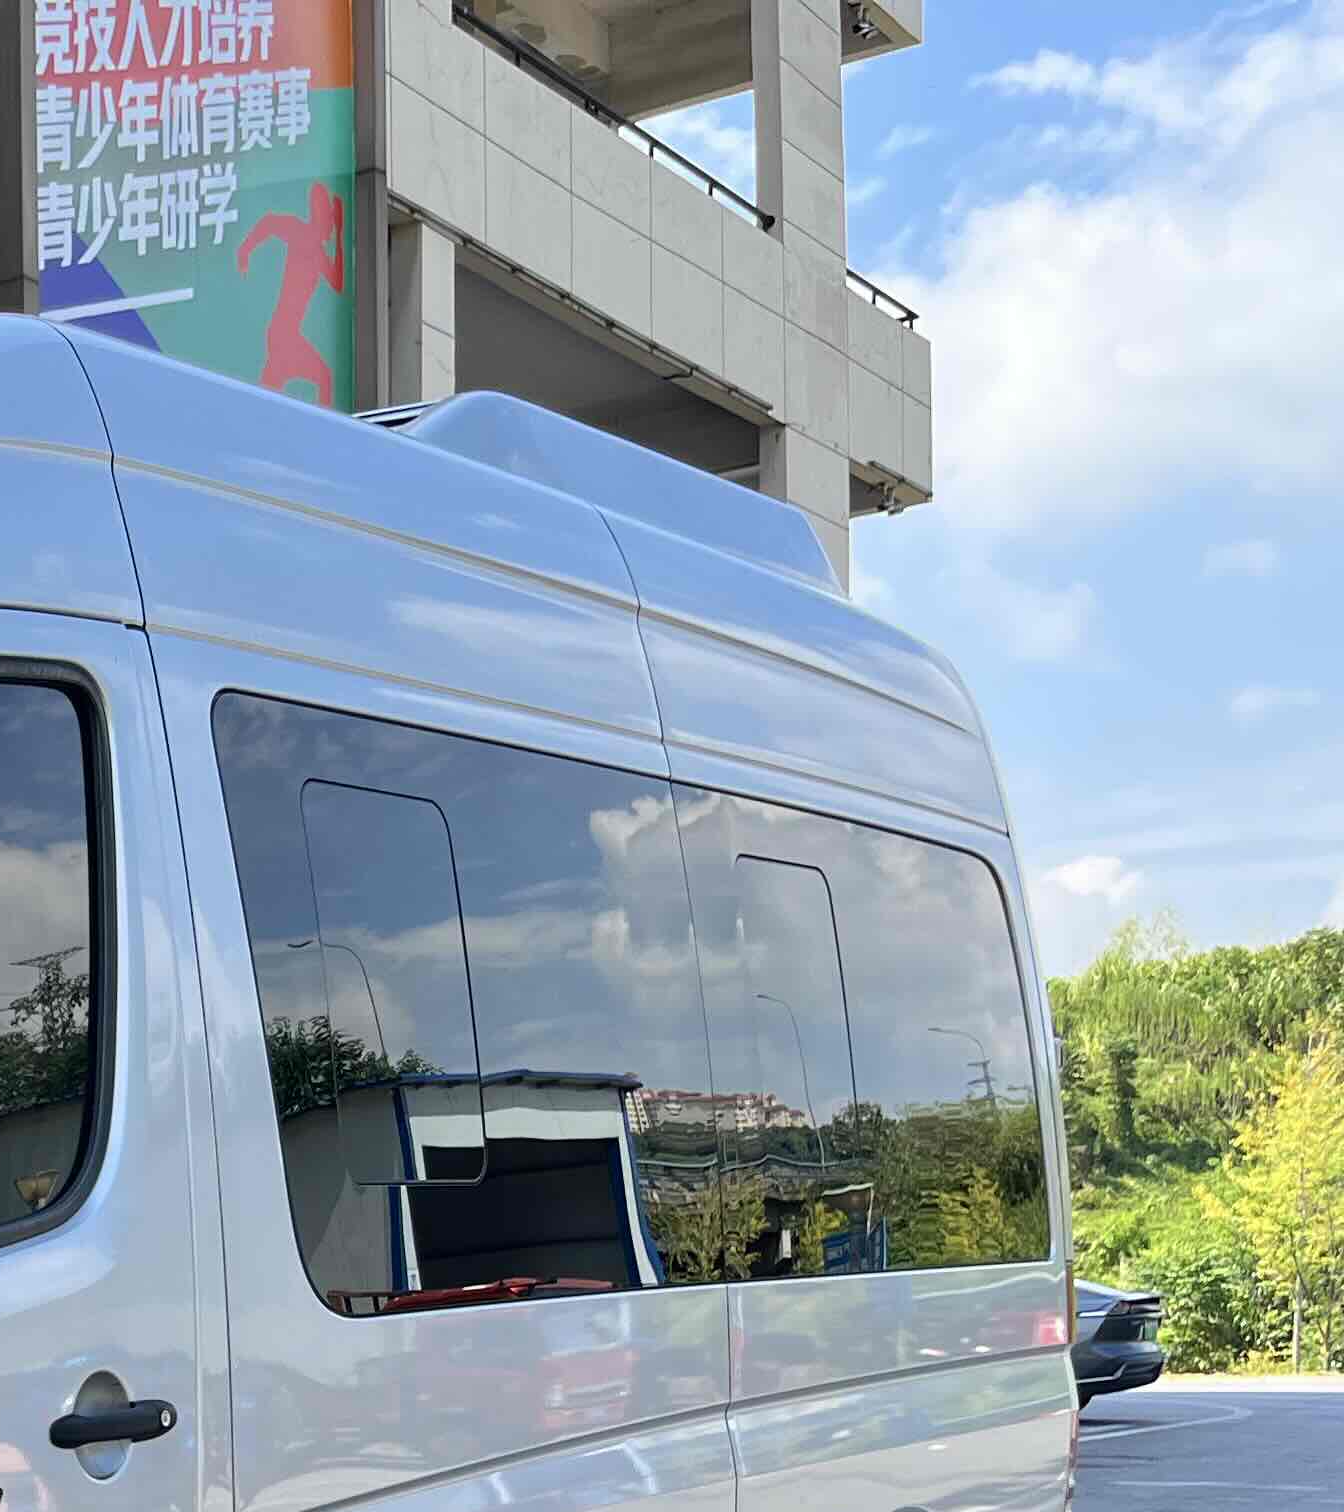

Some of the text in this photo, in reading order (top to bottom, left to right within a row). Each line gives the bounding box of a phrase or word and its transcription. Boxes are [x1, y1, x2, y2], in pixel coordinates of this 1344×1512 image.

[35, 0, 274, 75] 竞技人才培养
[36, 67, 311, 173] 青少年体育赛事
[37, 162, 238, 271] 青少年研学
